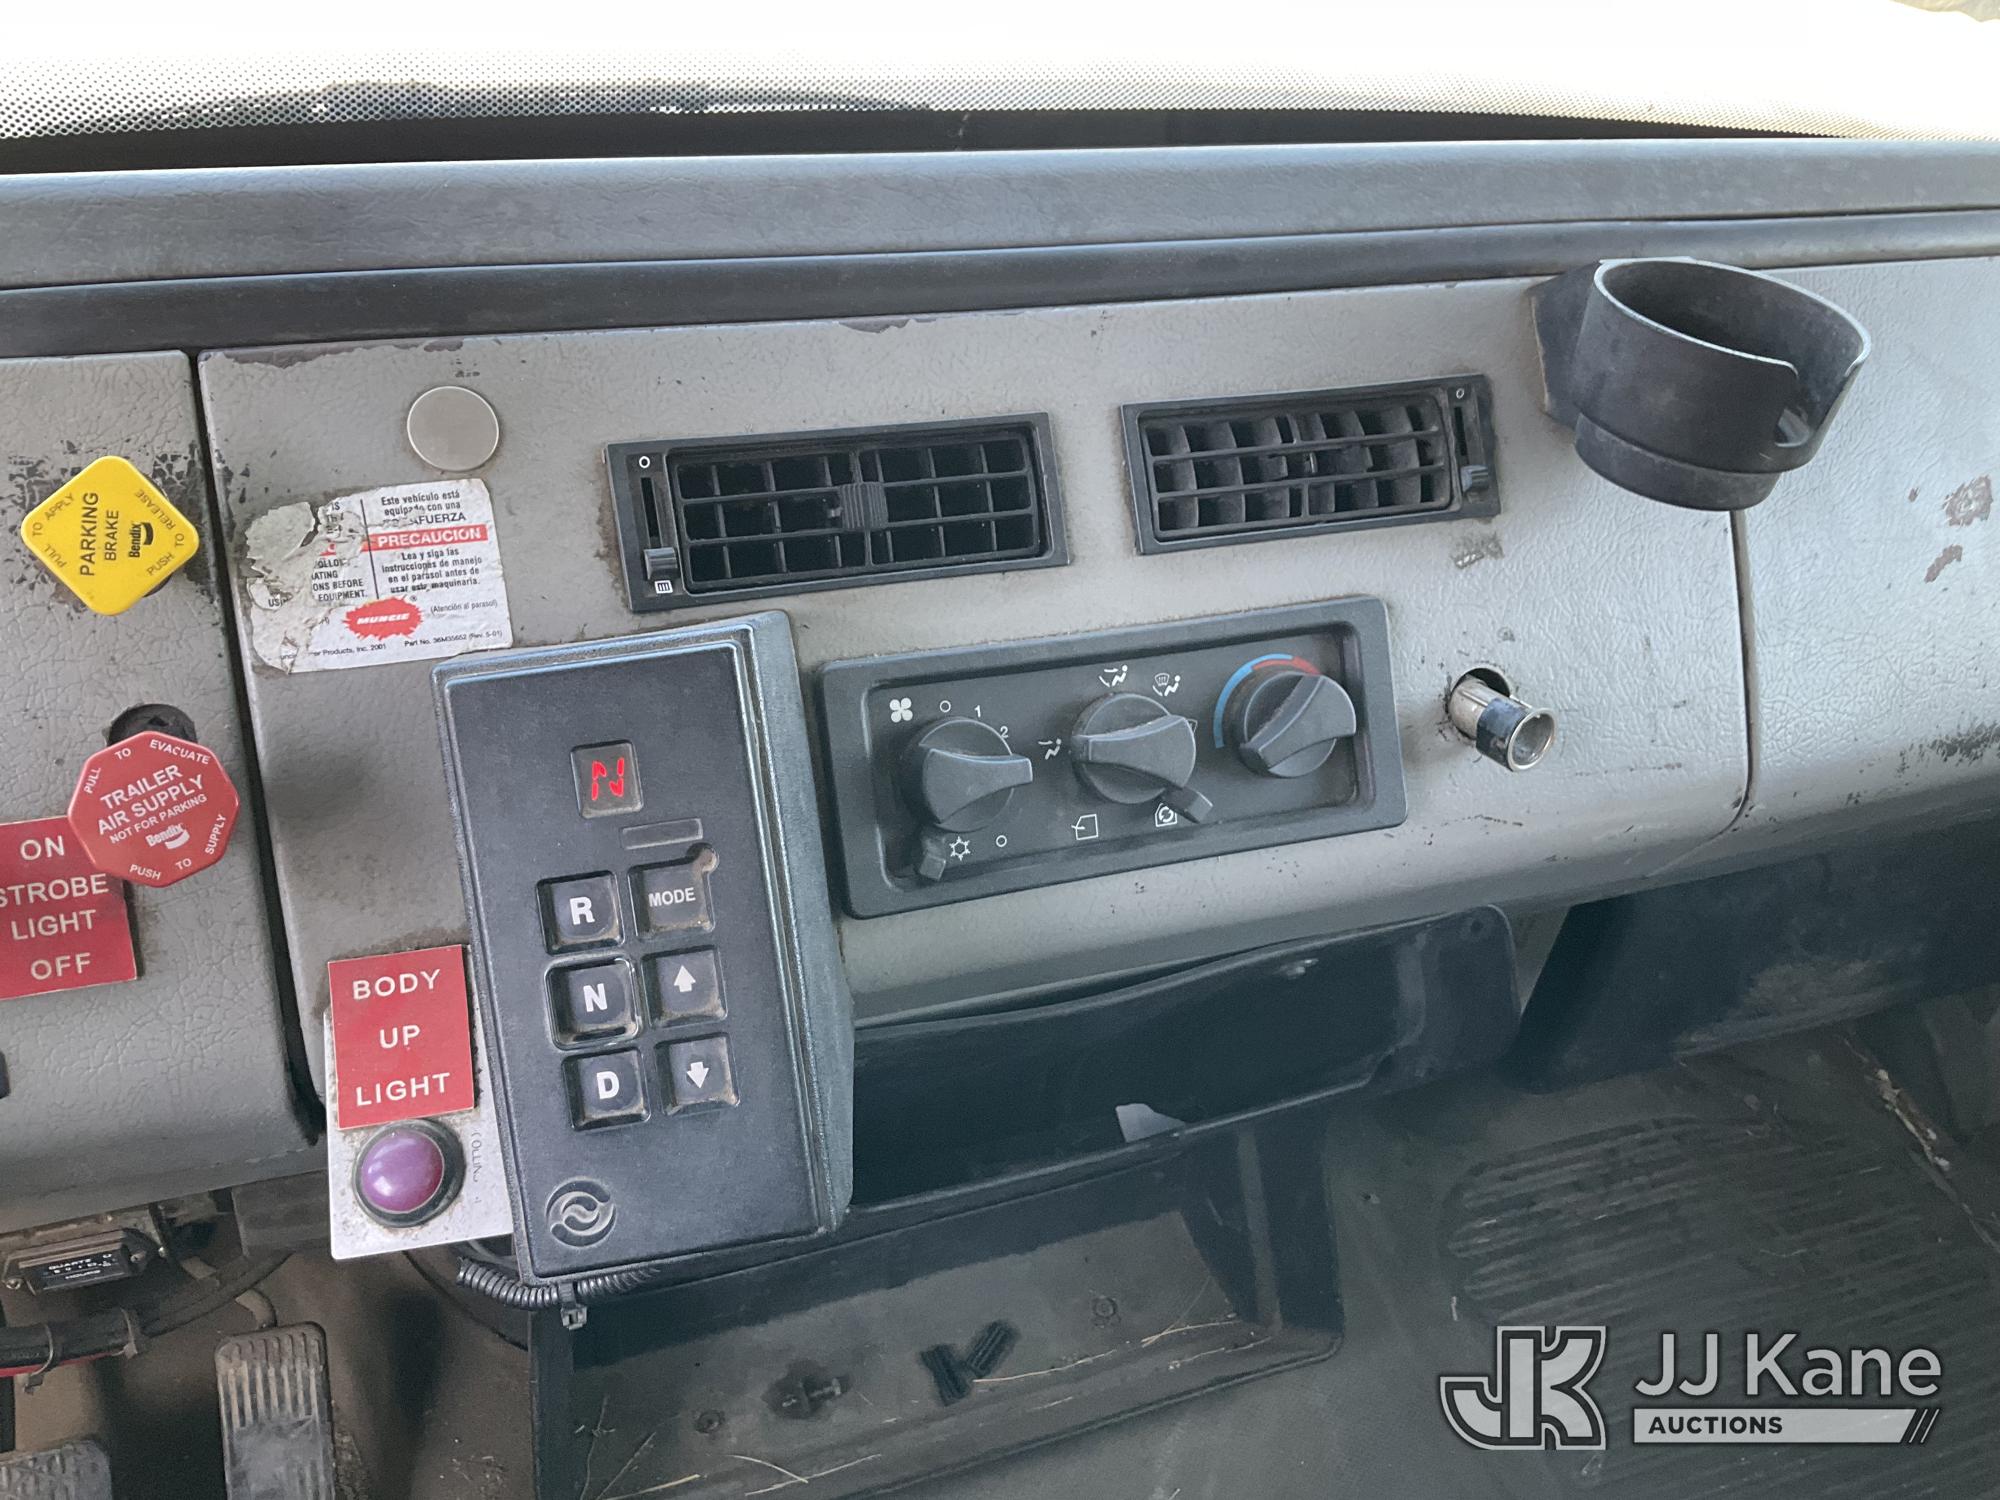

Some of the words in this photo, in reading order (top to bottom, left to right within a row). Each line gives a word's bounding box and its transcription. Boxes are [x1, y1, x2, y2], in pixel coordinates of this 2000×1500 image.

[44, 492, 76, 521] APPLY
[135, 489, 176, 530] RELEASE
[381, 496, 400, 506] Este
[402, 491, 439, 503] vehículo
[442, 489, 460, 499] está
[427, 503, 442, 511] con
[445, 501, 461, 509] una
[32, 522, 43, 537] TO
[80, 492, 99, 576] PARKING
[104, 510, 119, 561] BRAKE
[129, 523, 141, 558] Bendix
[175, 533, 185, 548] TO
[44, 545, 67, 568] PULL
[146, 553, 174, 576] PUSH
[401, 551, 417, 561] Lea
[420, 552, 425, 560] y
[427, 549, 444, 559] siga
[447, 548, 459, 556] las
[440, 559, 449, 567] de
[452, 556, 482, 567] manejo
[333, 578, 363, 589] BEFORE
[401, 574, 409, 582] el
[412, 570, 442, 581] parasol
[445, 568, 467, 577] antes
[470, 567, 479, 575] de
[356, 612, 410, 624] MUNCIE
[1000, 726, 1009, 738] 2
[83, 767, 101, 794] PULL
[115, 748, 131, 760] TO
[149, 739, 210, 765] EVACUATE
[591, 757, 625, 801] N
[100, 764, 183, 810] TRAILER
[97, 810, 131, 836] AIR
[132, 774, 206, 819] SUPPLY
[110, 826, 134, 844] NOT
[134, 814, 159, 834] FOR
[160, 793, 208, 823] PARKING
[20, 835, 65, 861] ON
[130, 863, 161, 880] PUSH
[175, 858, 192, 871] TO
[204, 814, 227, 855] SUPPLY
[145, 823, 183, 848] Bendix
[569, 896, 595, 925] R
[648, 887, 696, 907] MODE
[11, 909, 97, 941] LIGHT
[31, 952, 91, 981] OFF
[352, 969, 440, 1001] BODY
[583, 982, 608, 1013] N
[379, 1024, 421, 1049] UP
[356, 1072, 450, 1107] LIGHT
[596, 1070, 620, 1099] D
